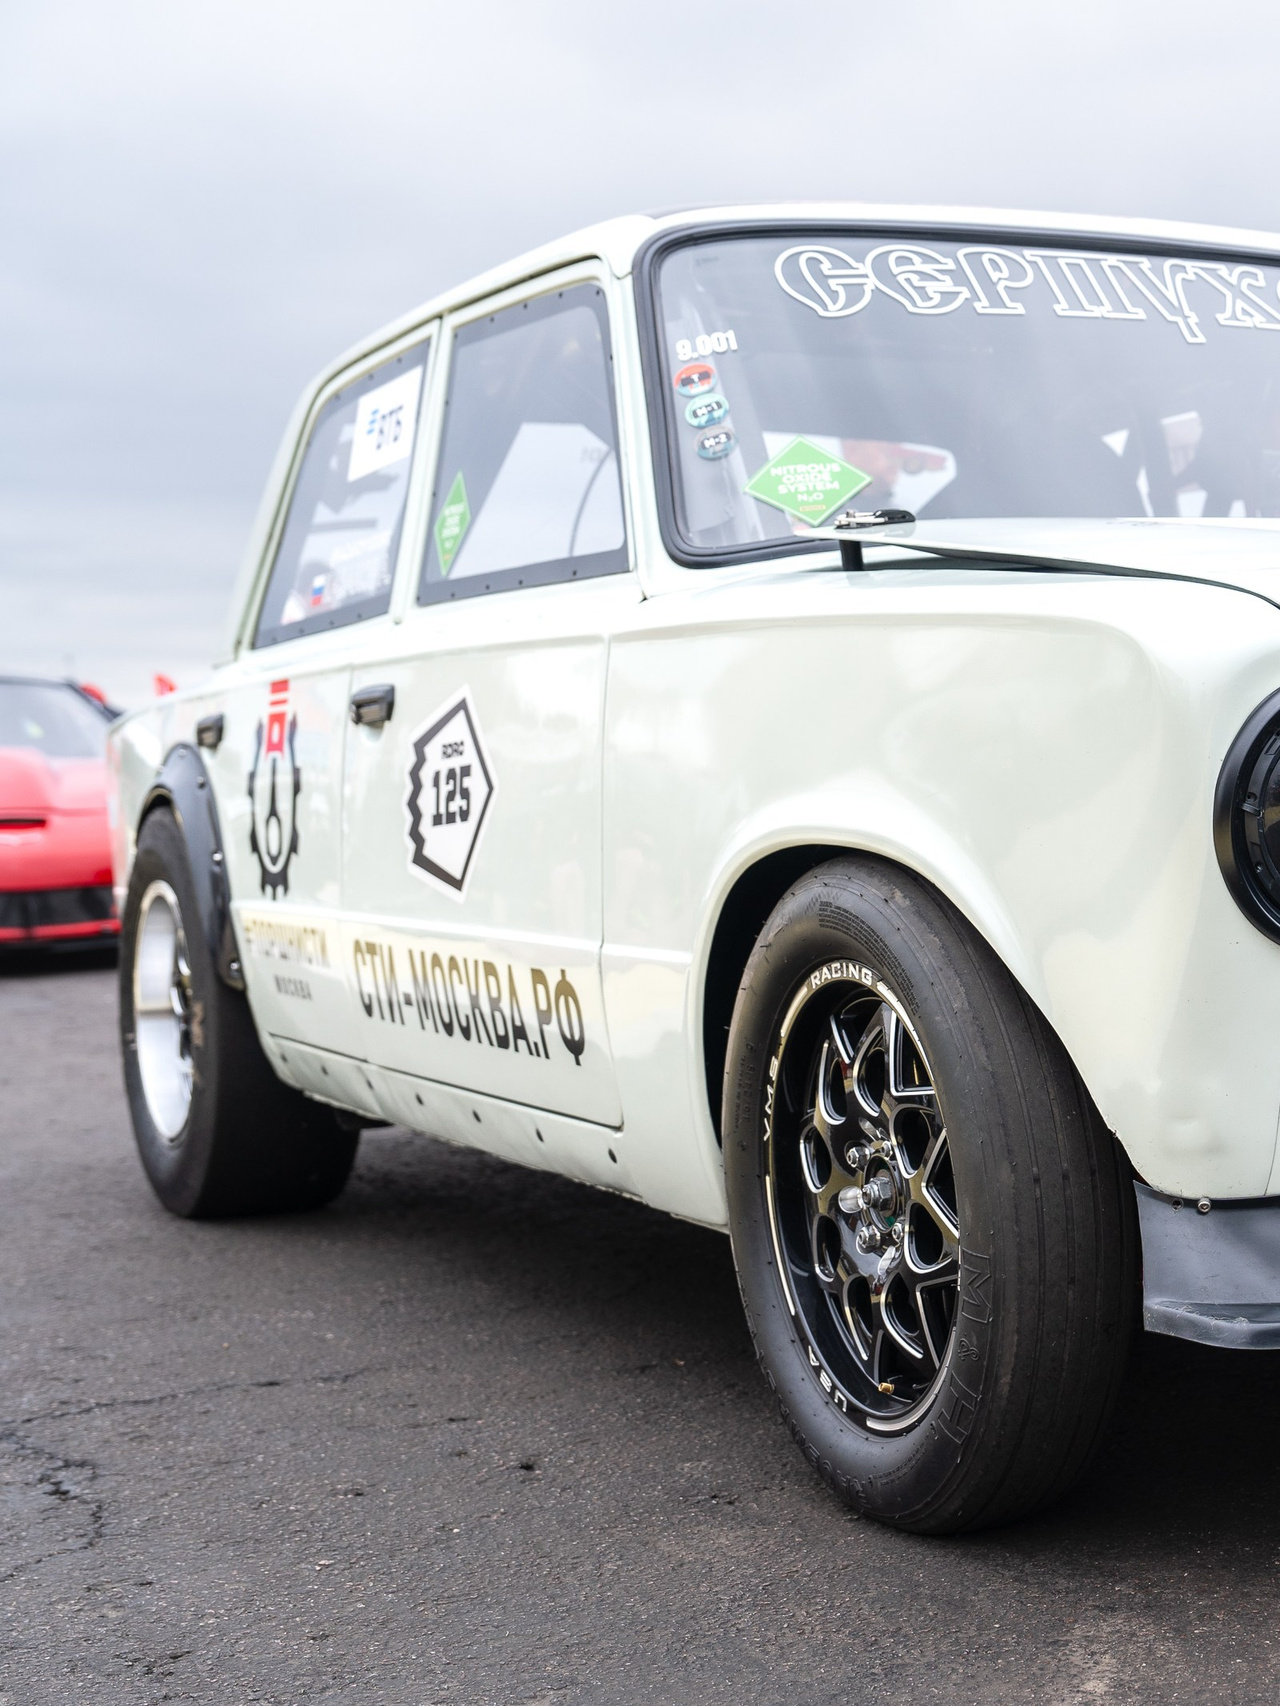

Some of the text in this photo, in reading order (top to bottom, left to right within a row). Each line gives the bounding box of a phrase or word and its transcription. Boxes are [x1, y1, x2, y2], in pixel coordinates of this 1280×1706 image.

[676, 329, 738, 361] 9.001
[770, 462, 841, 477] NITROUS
[782, 472, 832, 484] OXIDE
[777, 480, 840, 494] SYSTEM
[432, 764, 471, 826] 125
[810, 961, 874, 990] RACING
[353, 939, 586, 1067] СТИ-МОСКВА.РФ
[763, 1055, 780, 1141] VMS
[808, 1345, 848, 1412] USA
